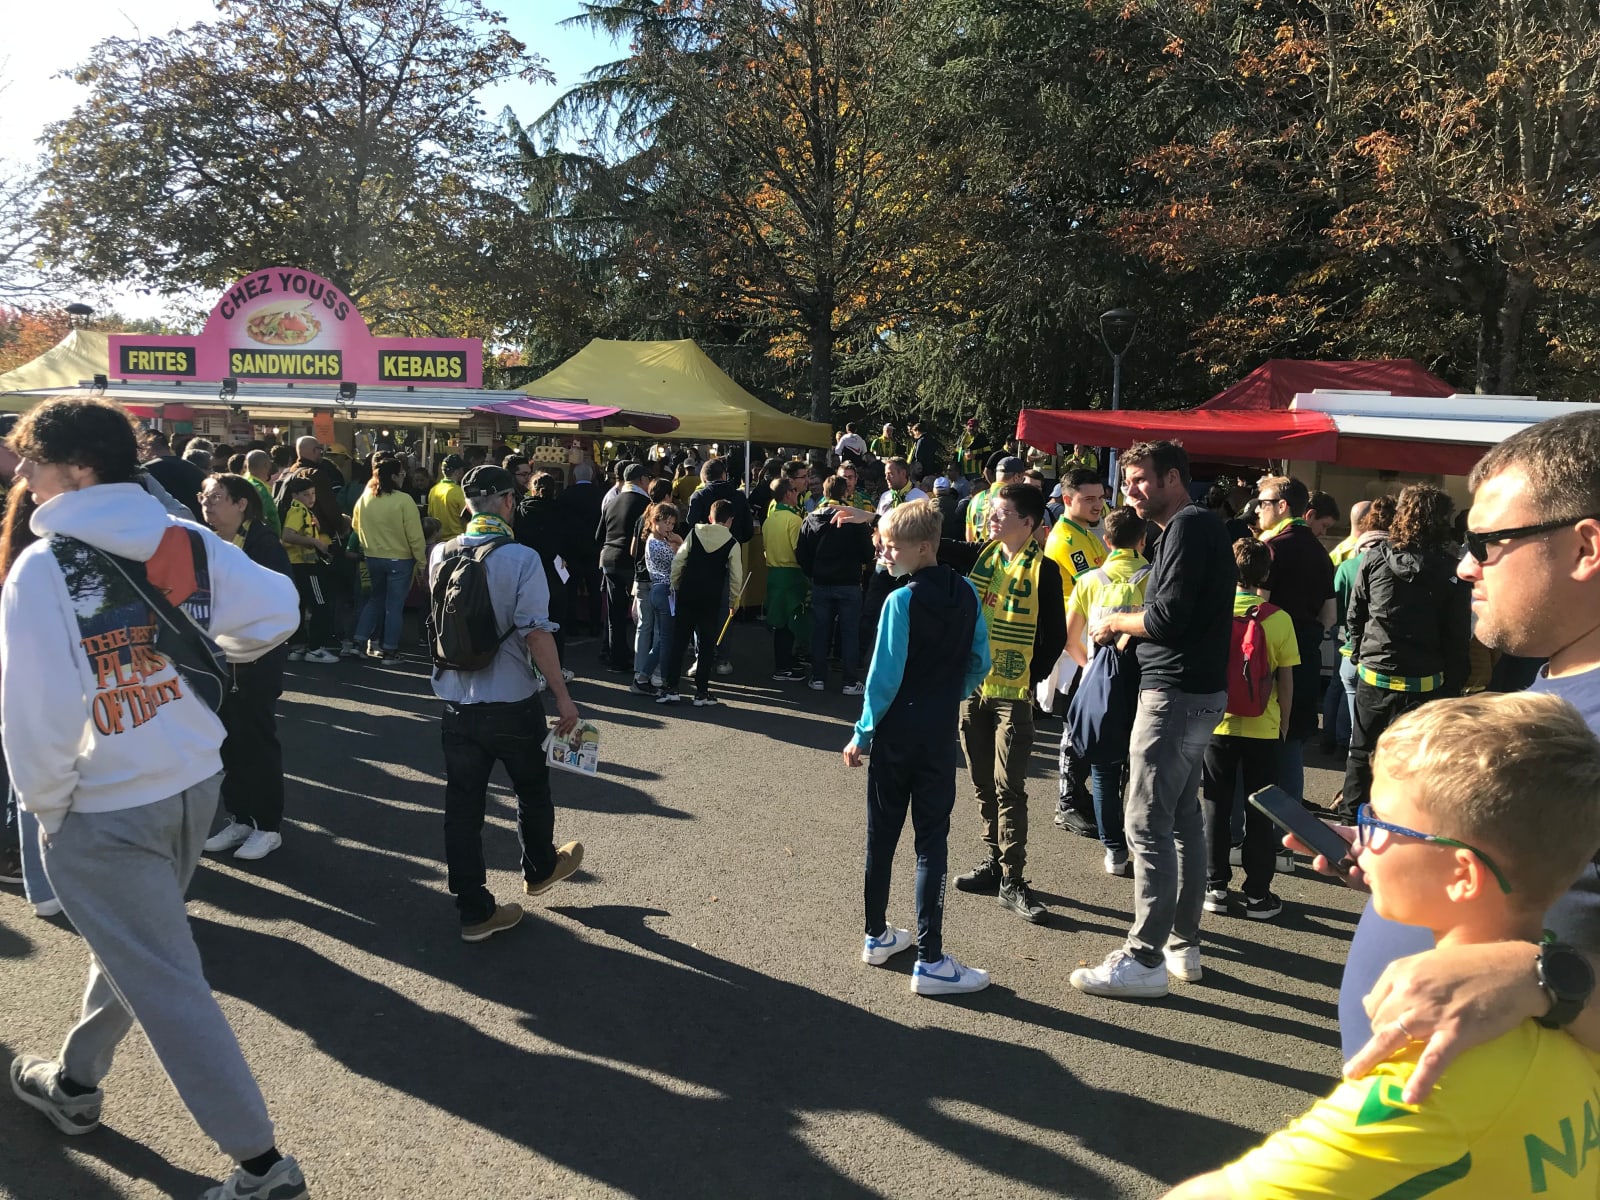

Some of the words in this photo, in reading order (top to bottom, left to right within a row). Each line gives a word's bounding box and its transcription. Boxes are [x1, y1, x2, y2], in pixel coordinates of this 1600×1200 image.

[220, 274, 272, 320] CHEZ
[278, 272, 350, 321] YOUSS
[128, 350, 188, 372] FRITES
[231, 351, 340, 376] SANDWICHS
[383, 355, 462, 379] KEBABS
[1003, 578, 1031, 614] FC
[80, 628, 130, 656] THE
[1523, 1099, 1600, 1195] NA
